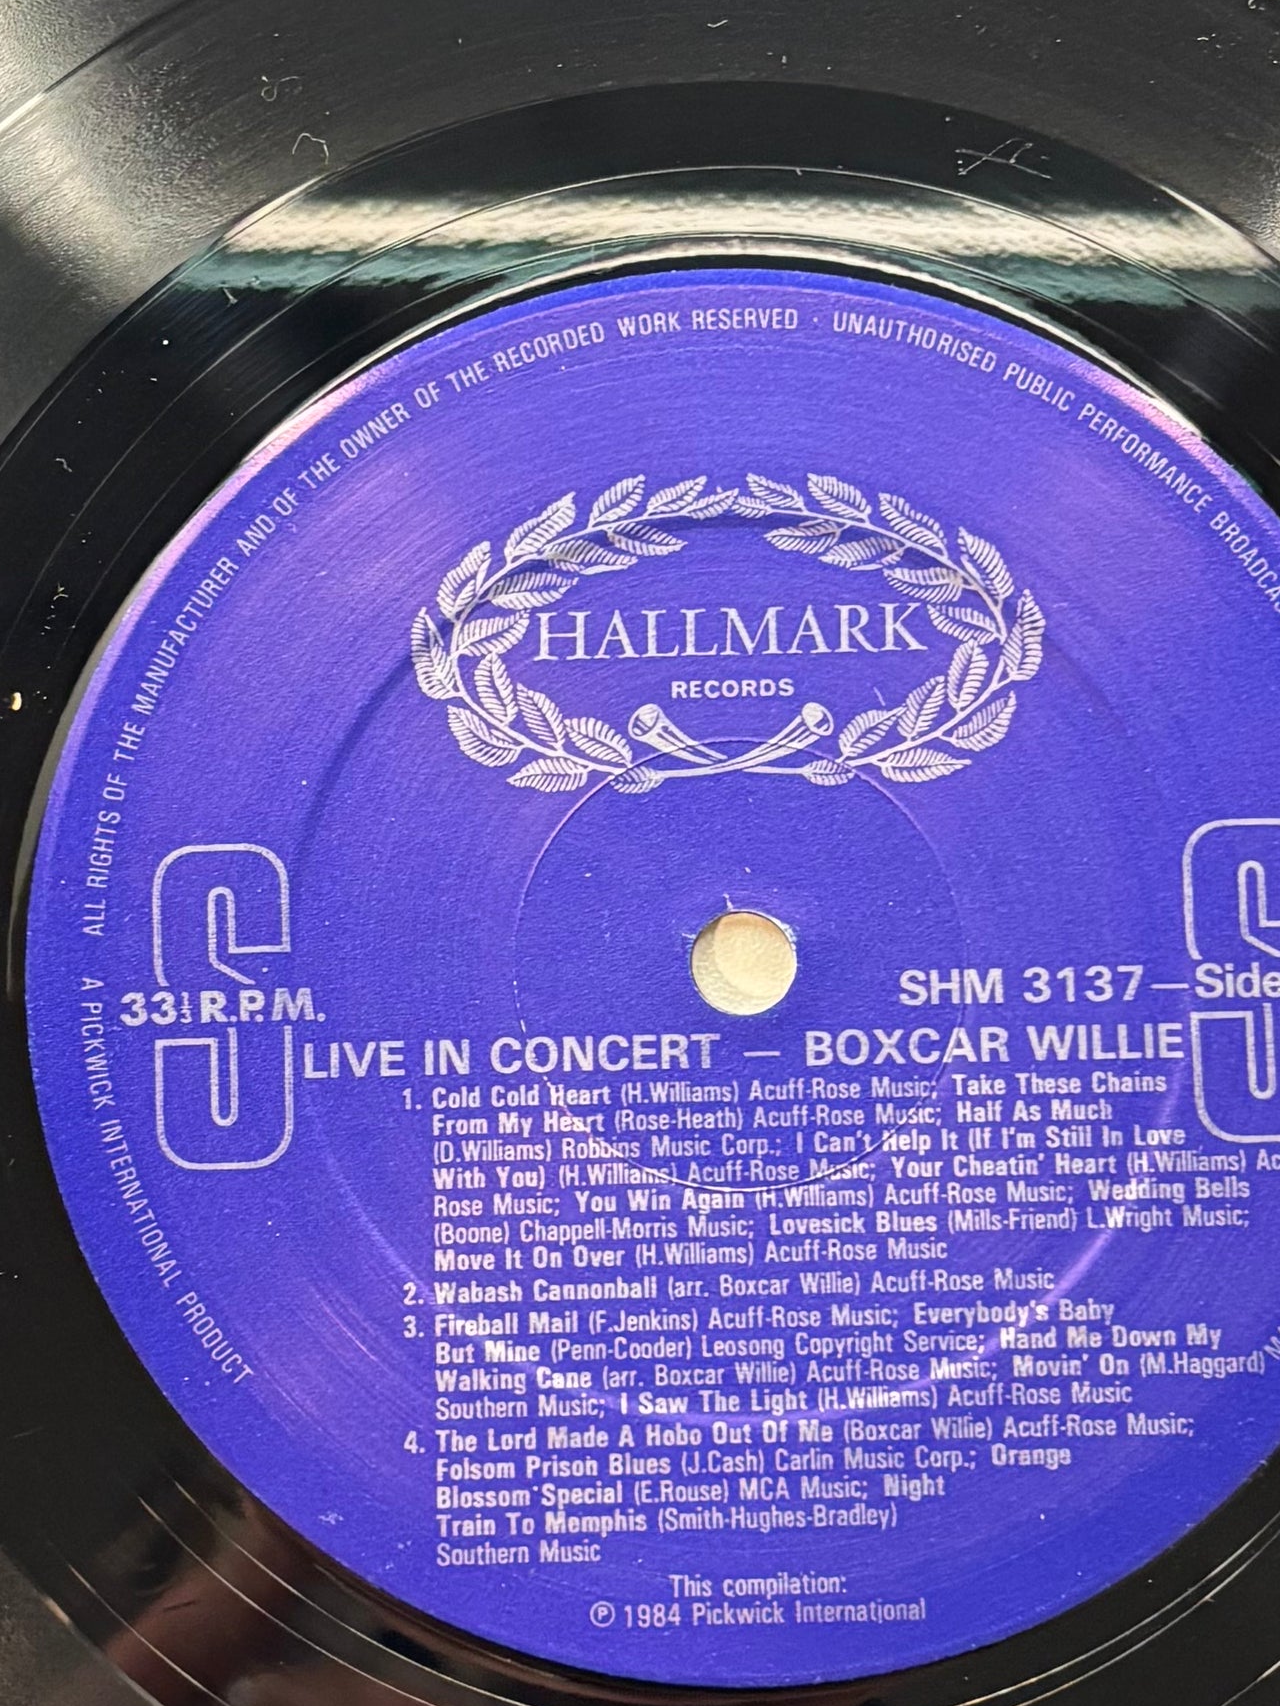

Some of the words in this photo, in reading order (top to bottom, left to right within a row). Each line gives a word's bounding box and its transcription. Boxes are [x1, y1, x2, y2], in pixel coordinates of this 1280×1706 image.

[617, 309, 680, 339] WORK
[691, 306, 798, 331] RESERVED
[492, 319, 605, 374] RECORDED
[832, 307, 1000, 374] UNAUTHORISED
[412, 379, 445, 410] OF
[444, 358, 489, 394] THE
[1001, 360, 1077, 413] PUBLIC
[337, 400, 411, 459] OWNER
[298, 450, 341, 491] THE
[1075, 401, 1212, 515] PERFORMANCE
[270, 485, 303, 517] OF
[233, 511, 277, 556] AND
[129, 554, 241, 717] MANUFACTURER
[532, 602, 928, 661] HALLMARK
[671, 678, 795, 699] RECORDS
[111, 719, 146, 765] THE
[101, 771, 130, 802] OF
[83, 808, 122, 888] RIGHTS
[80, 896, 107, 935] ALL
[899, 968, 1004, 1006] SHM
[303, 1040, 406, 1079] LIVE
[425, 1038, 470, 1076] IN
[490, 1033, 721, 1075] CONCERT
[805, 1026, 1010, 1067] BOXCAR
[1026, 1022, 1185, 1061] WILLIE
[402, 1087, 422, 1109] 1.
[432, 1086, 481, 1108] Cold
[491, 1085, 540, 1107] Cold
[951, 1073, 1006, 1096] Take
[1014, 1071, 1082, 1095] These
[1091, 1069, 1168, 1093] Chains
[432, 1112, 488, 1135] From
[498, 1111, 533, 1137] My
[614, 1107, 744, 1135] (Rose-Heath)
[956, 1101, 1003, 1123] Half
[1012, 1100, 1042, 1121] As
[1050, 1098, 1113, 1121] Much
[433, 1137, 552, 1166] (D.Williams)
[721, 1133, 781, 1159] Corp.;
[1045, 1125, 1092, 1147] Still
[1134, 1122, 1186, 1145] Love
[432, 1167, 486, 1189] With
[496, 1166, 546, 1191] You)
[891, 1156, 944, 1179] Your
[1055, 1152, 1117, 1174] Heart
[1127, 1149, 1247, 1177] (H.Williams)
[80, 1002, 115, 1109] PICKWICK
[98, 1117, 185, 1288] INTERNATIONAL
[174, 1288, 254, 1388] PRODUCT
[433, 1194, 483, 1216] Rose
[575, 1190, 617, 1212] You
[627, 1188, 671, 1211] Win
[681, 1187, 745, 1214] Again
[1088, 1177, 1185, 1204] Wedding
[1195, 1175, 1251, 1197] Bells
[434, 1221, 510, 1248] (Boone)
[519, 1217, 678, 1246] Chappell-Morris
[769, 1212, 866, 1236] Lovesick
[875, 1211, 938, 1234] Blues
[947, 1208, 1078, 1235] (Mills-Friend)
[1086, 1205, 1173, 1233] L.Wright
[434, 1248, 495, 1271] Move
[532, 1246, 563, 1268] On
[573, 1244, 625, 1268] Over
[403, 1282, 424, 1305] 2.
[434, 1280, 523, 1304] Wabash
[533, 1277, 658, 1302] Cannonball
[668, 1276, 709, 1302] (arr.
[719, 1274, 790, 1296] Boxcar
[799, 1272, 861, 1298] Willie)
[403, 1315, 425, 1337] 3.
[434, 1312, 519, 1336] Fireball
[528, 1311, 578, 1334] Mail
[588, 1308, 698, 1336] (F.Jenkins)
[1059, 1298, 1115, 1324] Baby
[435, 1342, 475, 1365] But
[484, 1340, 541, 1363] Mine
[551, 1336, 692, 1365] (Penn-Cooder)
[701, 1334, 785, 1362] Leosong
[795, 1332, 893, 1359] Copyright
[903, 1328, 985, 1356] Service;
[999, 1327, 1057, 1349] Hand
[1067, 1326, 1102, 1348] Me
[1111, 1324, 1177, 1347] Down
[1186, 1322, 1222, 1349] My
[434, 1368, 526, 1396] Walking
[536, 1366, 592, 1390] Cane
[602, 1365, 645, 1391] (arr.
[655, 1363, 726, 1386] Boxcar
[735, 1361, 797, 1388] Willie)
[1099, 1353, 1130, 1376] On
[1139, 1350, 1265, 1379] (M.Haggard)
[435, 1396, 528, 1420] Southern
[637, 1392, 689, 1415] Saw
[701, 1390, 740, 1413] The
[751, 1389, 808, 1416] Light
[403, 1430, 426, 1452] 4.
[434, 1429, 478, 1451] The
[487, 1428, 537, 1450] Lord
[547, 1425, 609, 1449] Made
[646, 1423, 702, 1446] Hobo
[712, 1422, 752, 1445] Out
[762, 1421, 787, 1443] Of
[798, 1420, 833, 1442] Me
[844, 1418, 921, 1445] (Boxcar
[931, 1417, 993, 1443] Willie)
[436, 1456, 516, 1480] Folsom
[526, 1454, 598, 1478] Prison
[609, 1452, 671, 1476] Blues
[681, 1450, 764, 1478] (J.Cash)
[775, 1450, 834, 1472] Carlin
[915, 1446, 976, 1473] Corp.;
[991, 1444, 1072, 1471] Orange
[436, 1485, 531, 1509] Blossom
[541, 1482, 623, 1510] Special
[634, 1480, 729, 1507] (E.Rouse)
[739, 1478, 790, 1500] MCA
[883, 1473, 945, 1501] Night
[435, 1514, 496, 1537] Train
[505, 1512, 535, 1535] To
[544, 1509, 648, 1538] Memphis
[658, 1503, 897, 1534] (Smith-Hughes-Bradley)
[436, 1543, 530, 1567] Southern
[539, 1540, 601, 1563] Music
[669, 1574, 713, 1597] This
[722, 1572, 847, 1601] compilation:
[624, 1602, 681, 1624] 1984
[692, 1600, 785, 1624] Pickwick
[795, 1600, 926, 1624] International
